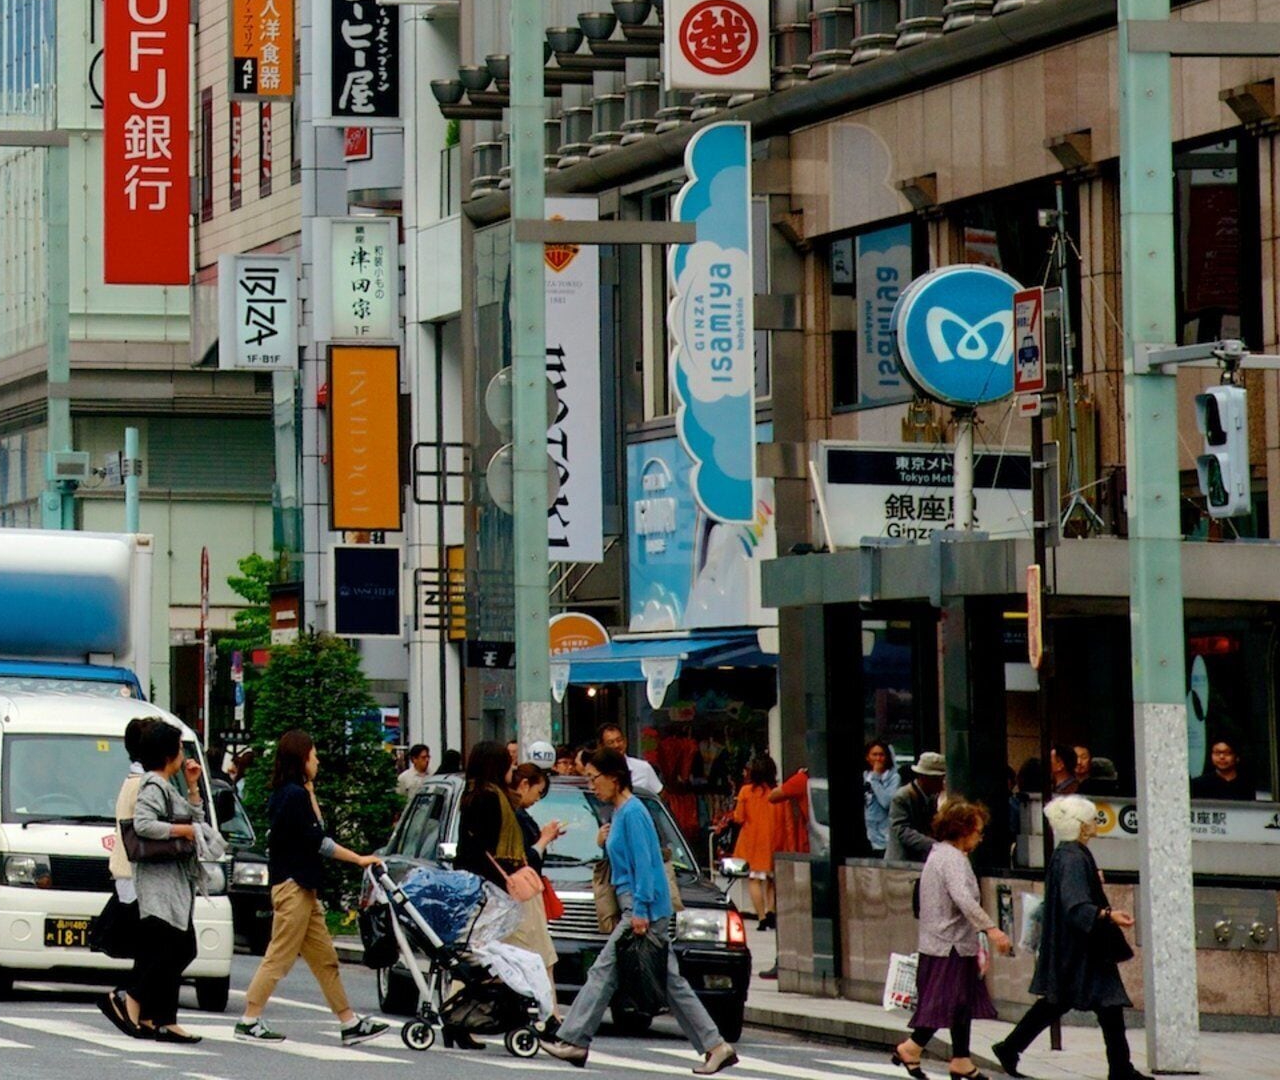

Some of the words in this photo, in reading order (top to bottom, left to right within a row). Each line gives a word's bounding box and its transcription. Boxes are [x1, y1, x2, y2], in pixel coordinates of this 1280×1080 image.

[895, 457, 954, 471] 東京メト
[900, 472, 930, 483] Tokyo
[932, 472, 954, 483] Met
